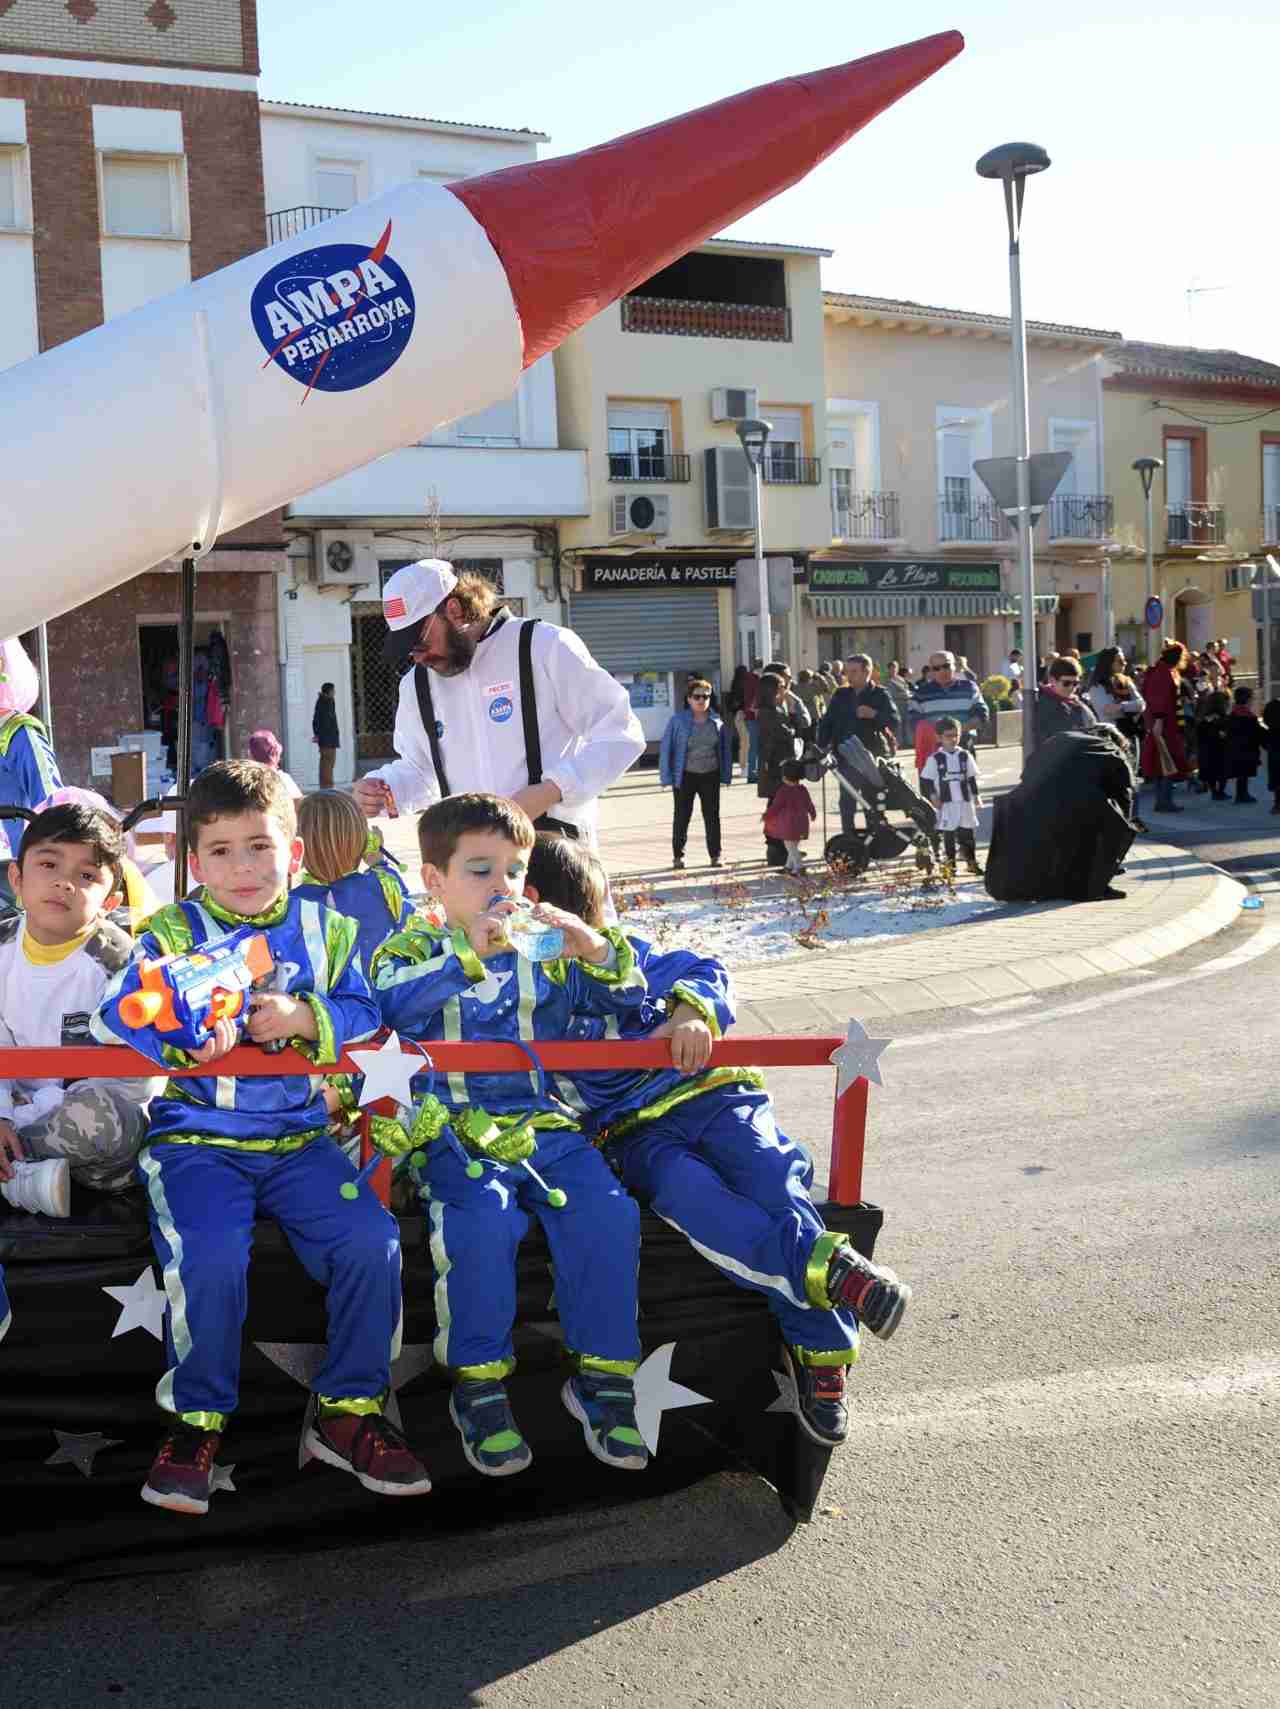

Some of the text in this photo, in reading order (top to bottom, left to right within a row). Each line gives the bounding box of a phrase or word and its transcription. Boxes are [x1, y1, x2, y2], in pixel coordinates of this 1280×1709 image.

[264, 258, 397, 339] AMPA
[281, 296, 411, 367] PEÑARROYA
[594, 562, 736, 581] PANADERÍA & PASTELE
